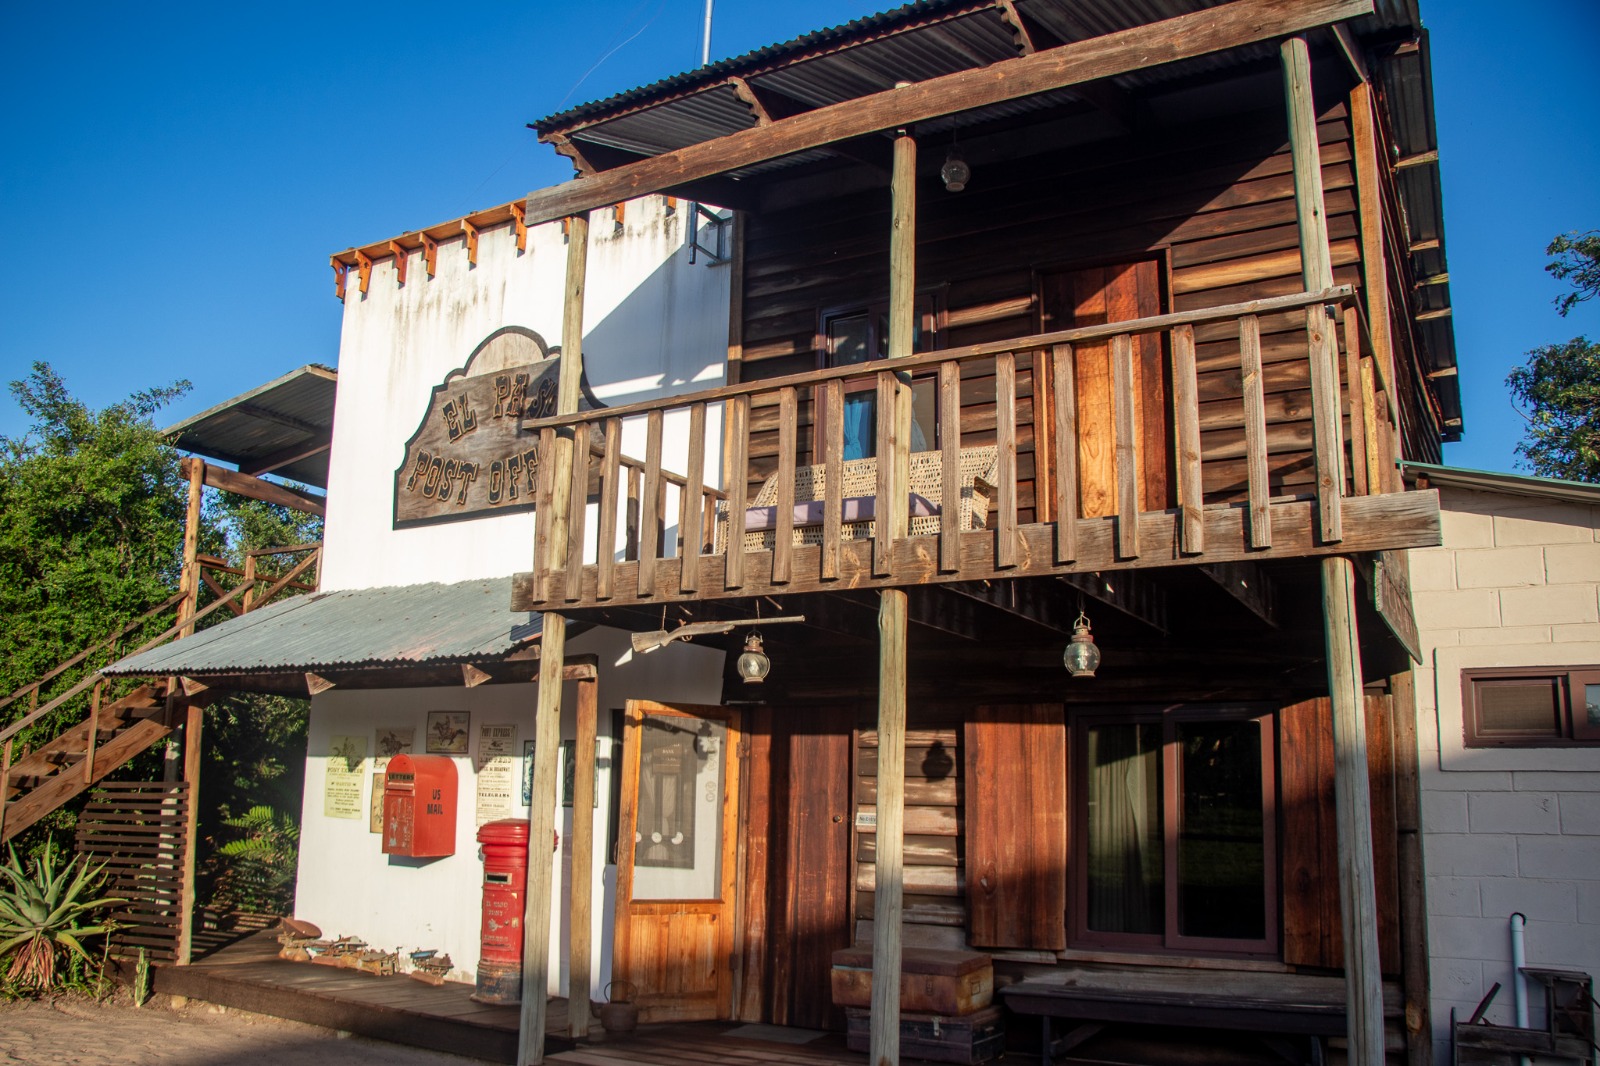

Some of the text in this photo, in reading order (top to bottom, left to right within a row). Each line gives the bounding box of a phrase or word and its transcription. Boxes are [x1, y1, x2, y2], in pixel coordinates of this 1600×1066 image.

[442, 391, 478, 444] EL
[406, 448, 479, 505] POST
[426, 803, 443, 815] MAIL
[432, 789, 441, 800] US
